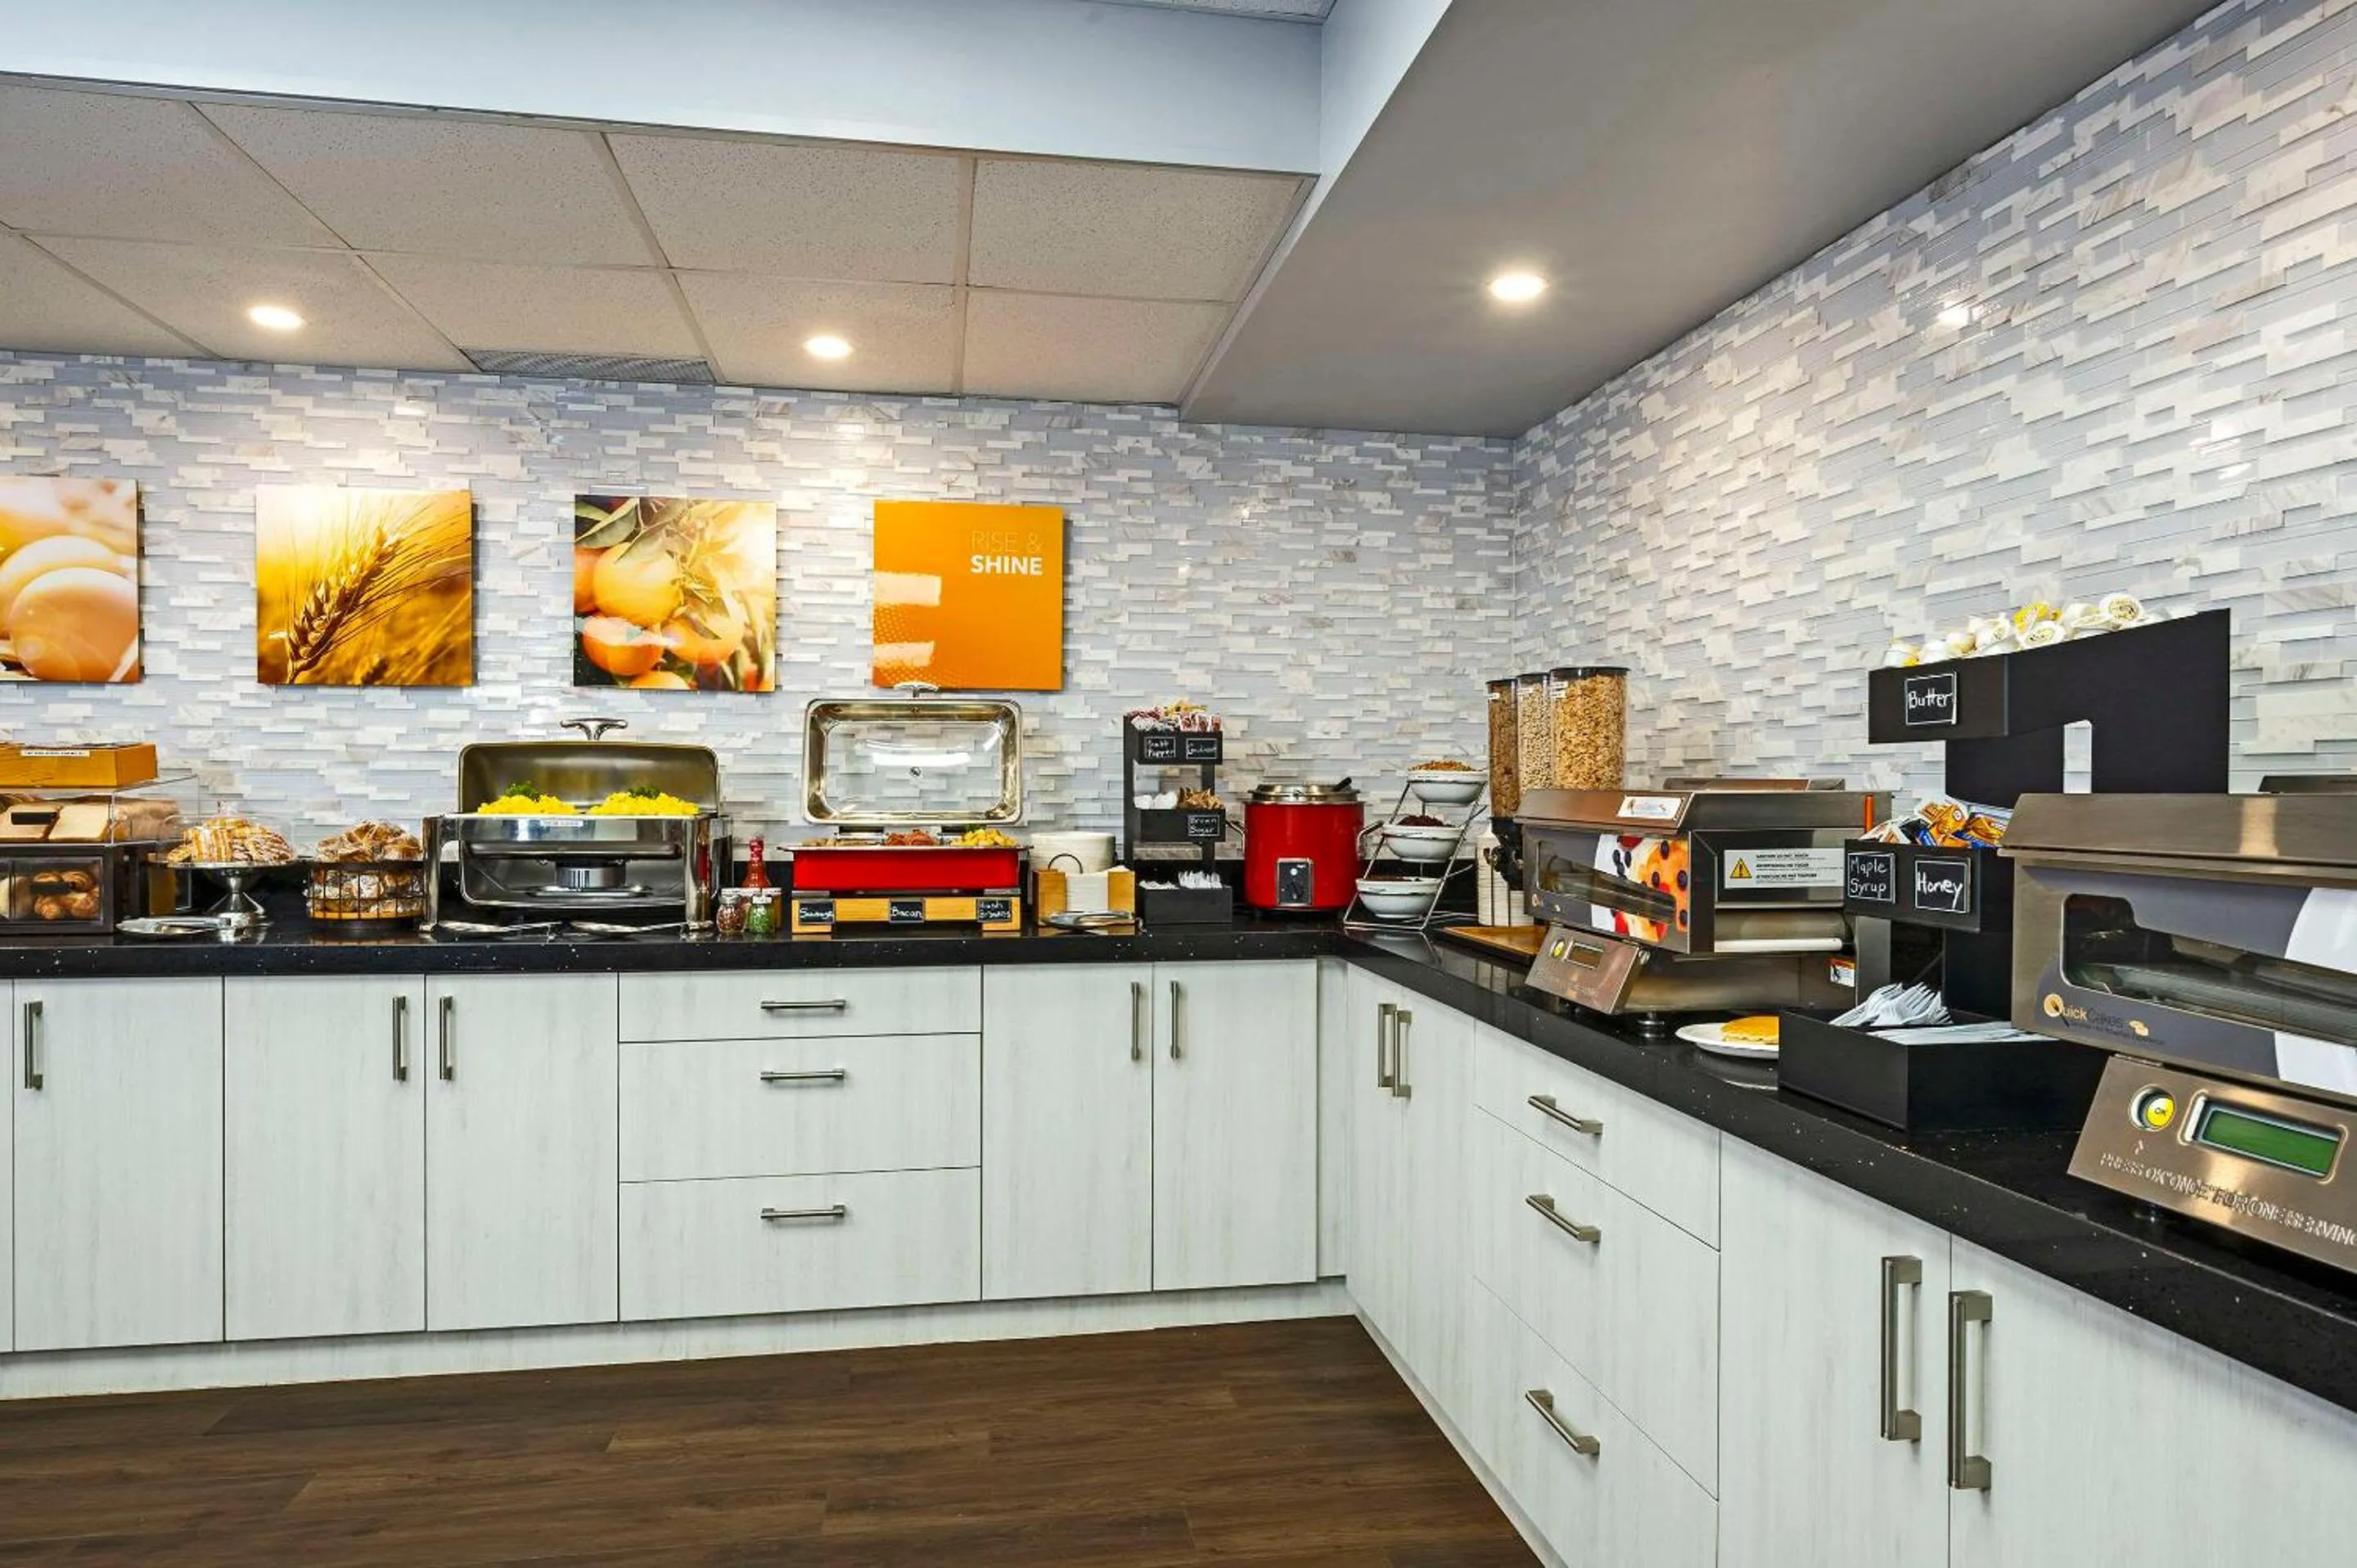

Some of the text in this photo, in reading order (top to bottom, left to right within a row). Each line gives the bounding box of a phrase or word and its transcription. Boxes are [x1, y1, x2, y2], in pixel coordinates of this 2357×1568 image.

[971, 530, 1045, 554] RISE &
[969, 554, 1043, 575] SHINE
[1908, 687, 1953, 710] Butter
[1850, 857, 1888, 877] Maple
[1850, 878, 1886, 899] Syrup
[1917, 872, 1963, 910] Honey
[890, 906, 923, 918] Bacon
